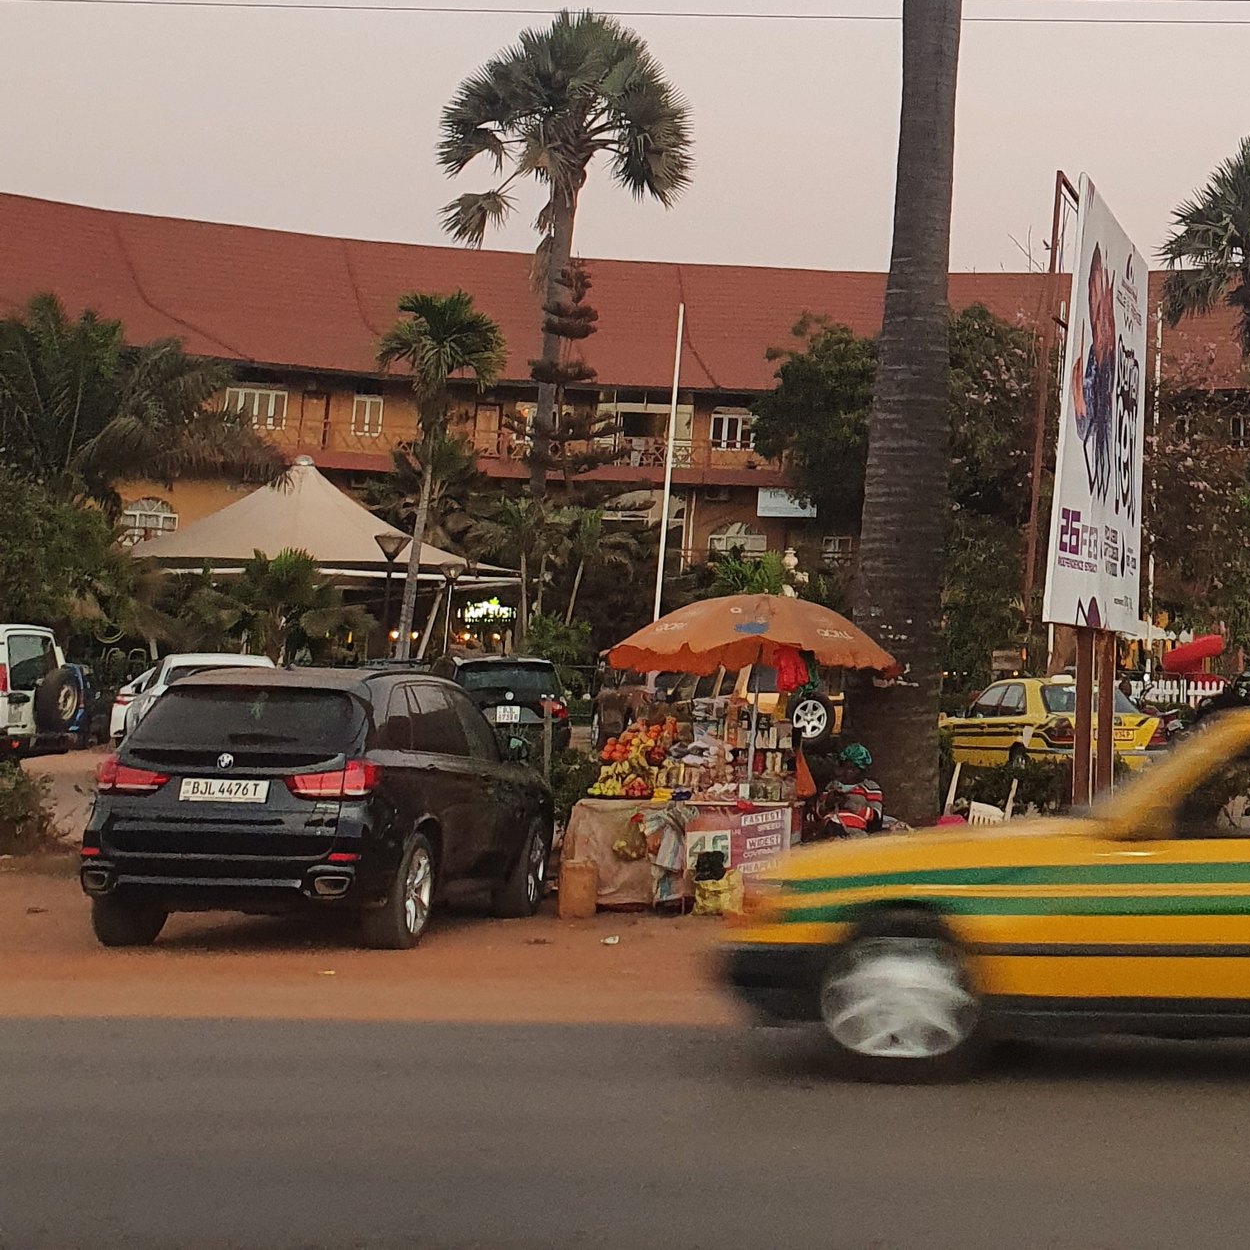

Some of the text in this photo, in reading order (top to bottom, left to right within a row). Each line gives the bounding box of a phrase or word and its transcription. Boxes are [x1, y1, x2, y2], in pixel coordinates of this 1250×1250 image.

[1059, 507, 1081, 555] 26
[191, 781, 260, 796] BJL 4476 T
[743, 811, 780, 825] FASTEST
[748, 835, 780, 849] WIDEST
